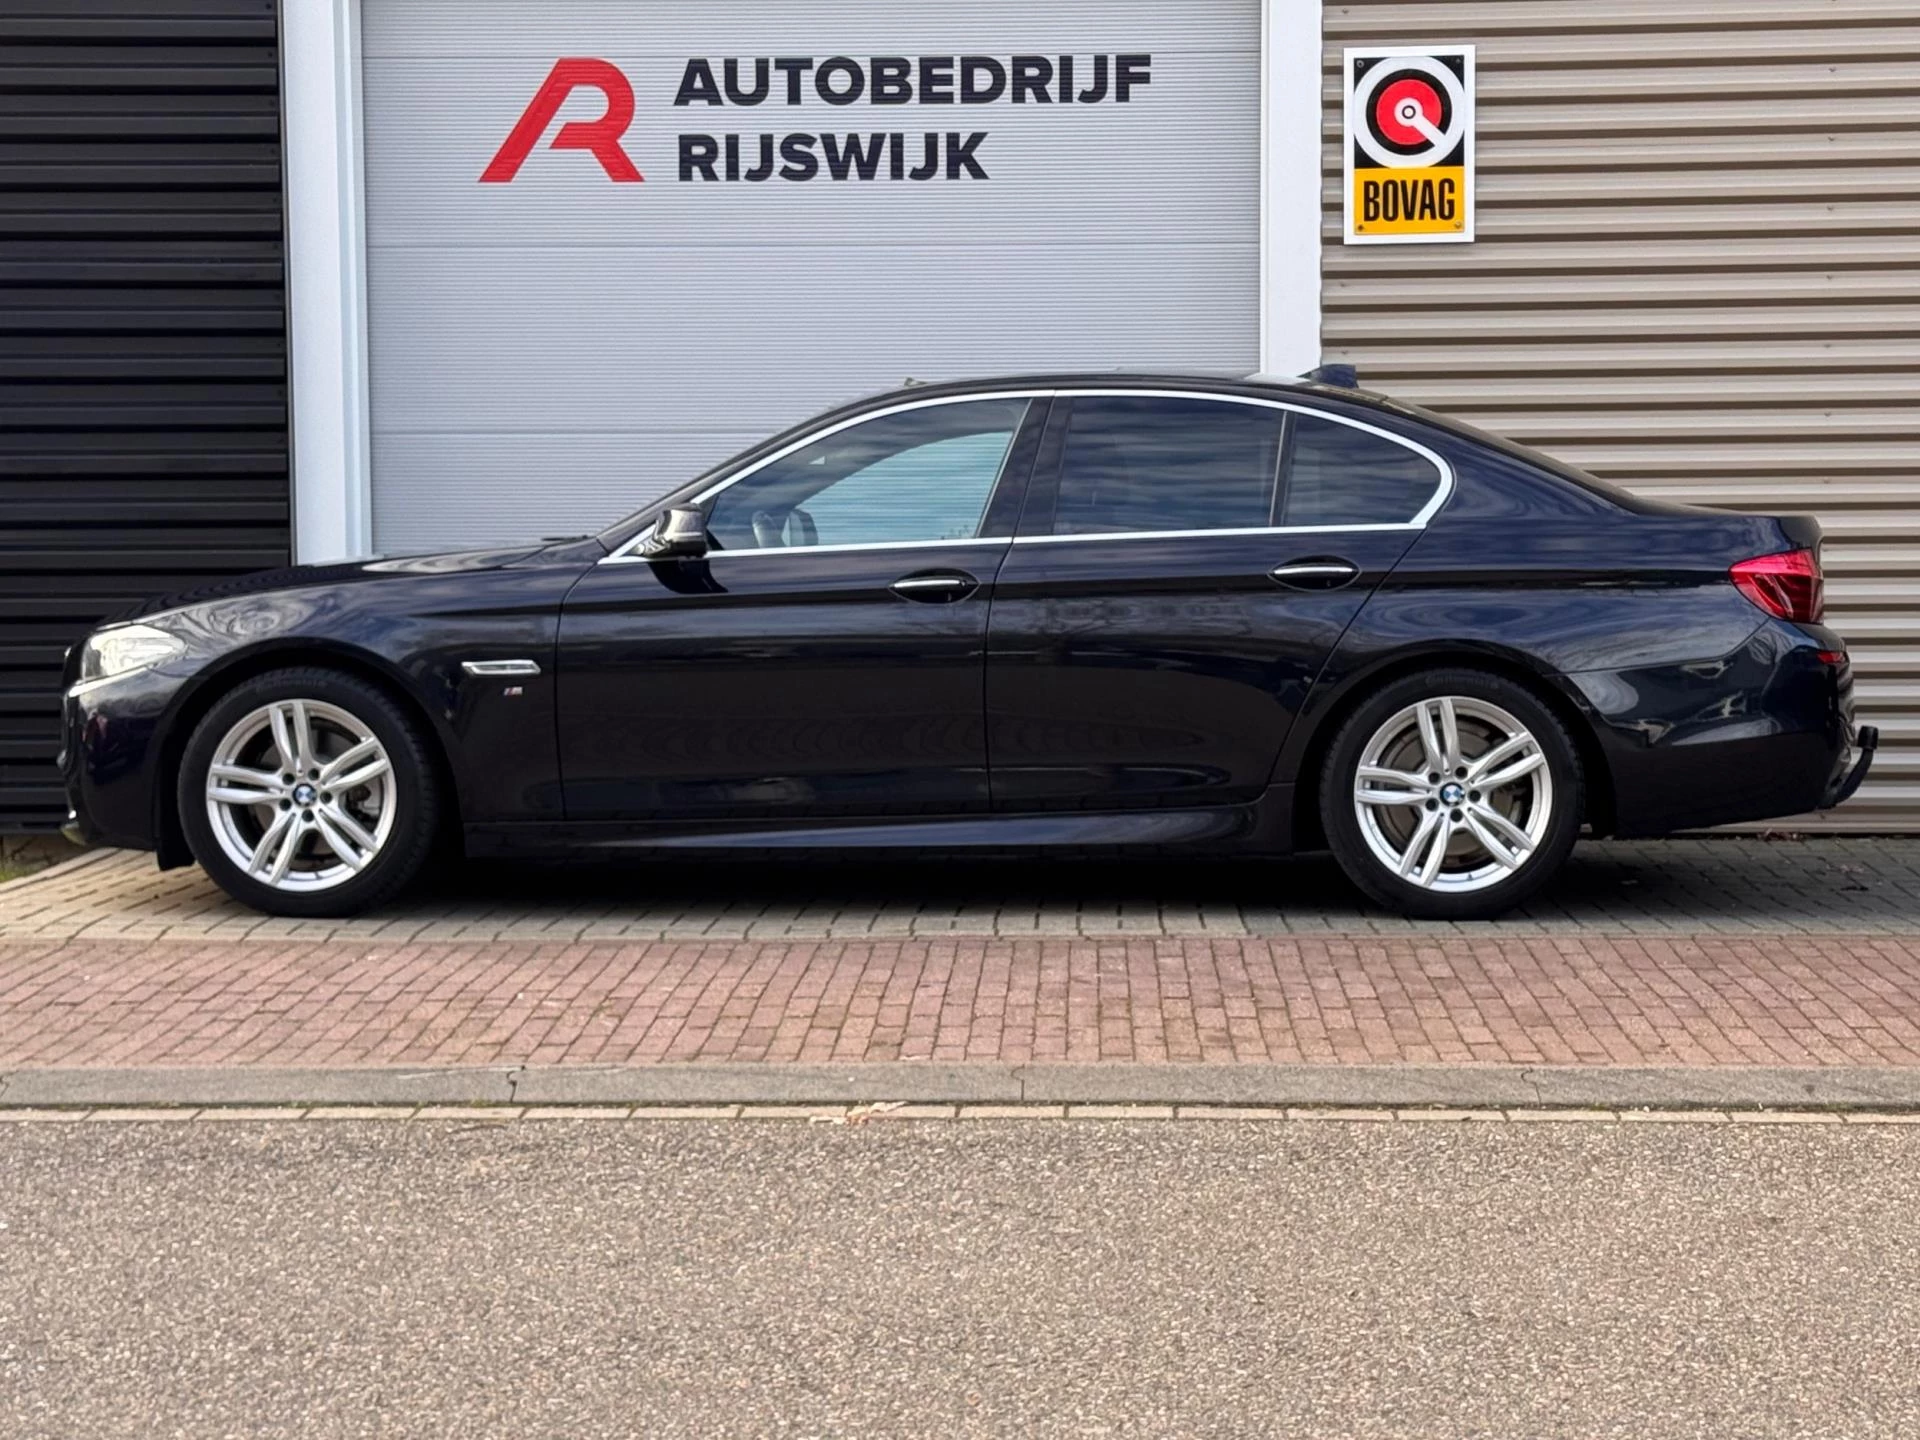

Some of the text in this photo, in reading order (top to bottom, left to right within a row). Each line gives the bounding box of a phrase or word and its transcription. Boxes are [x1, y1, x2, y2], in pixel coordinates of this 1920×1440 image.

[674, 55, 1151, 106] AUTOBEDRIJF
[679, 132, 988, 181] RIJSWIJK
[1364, 178, 1454, 221] BOVAG
